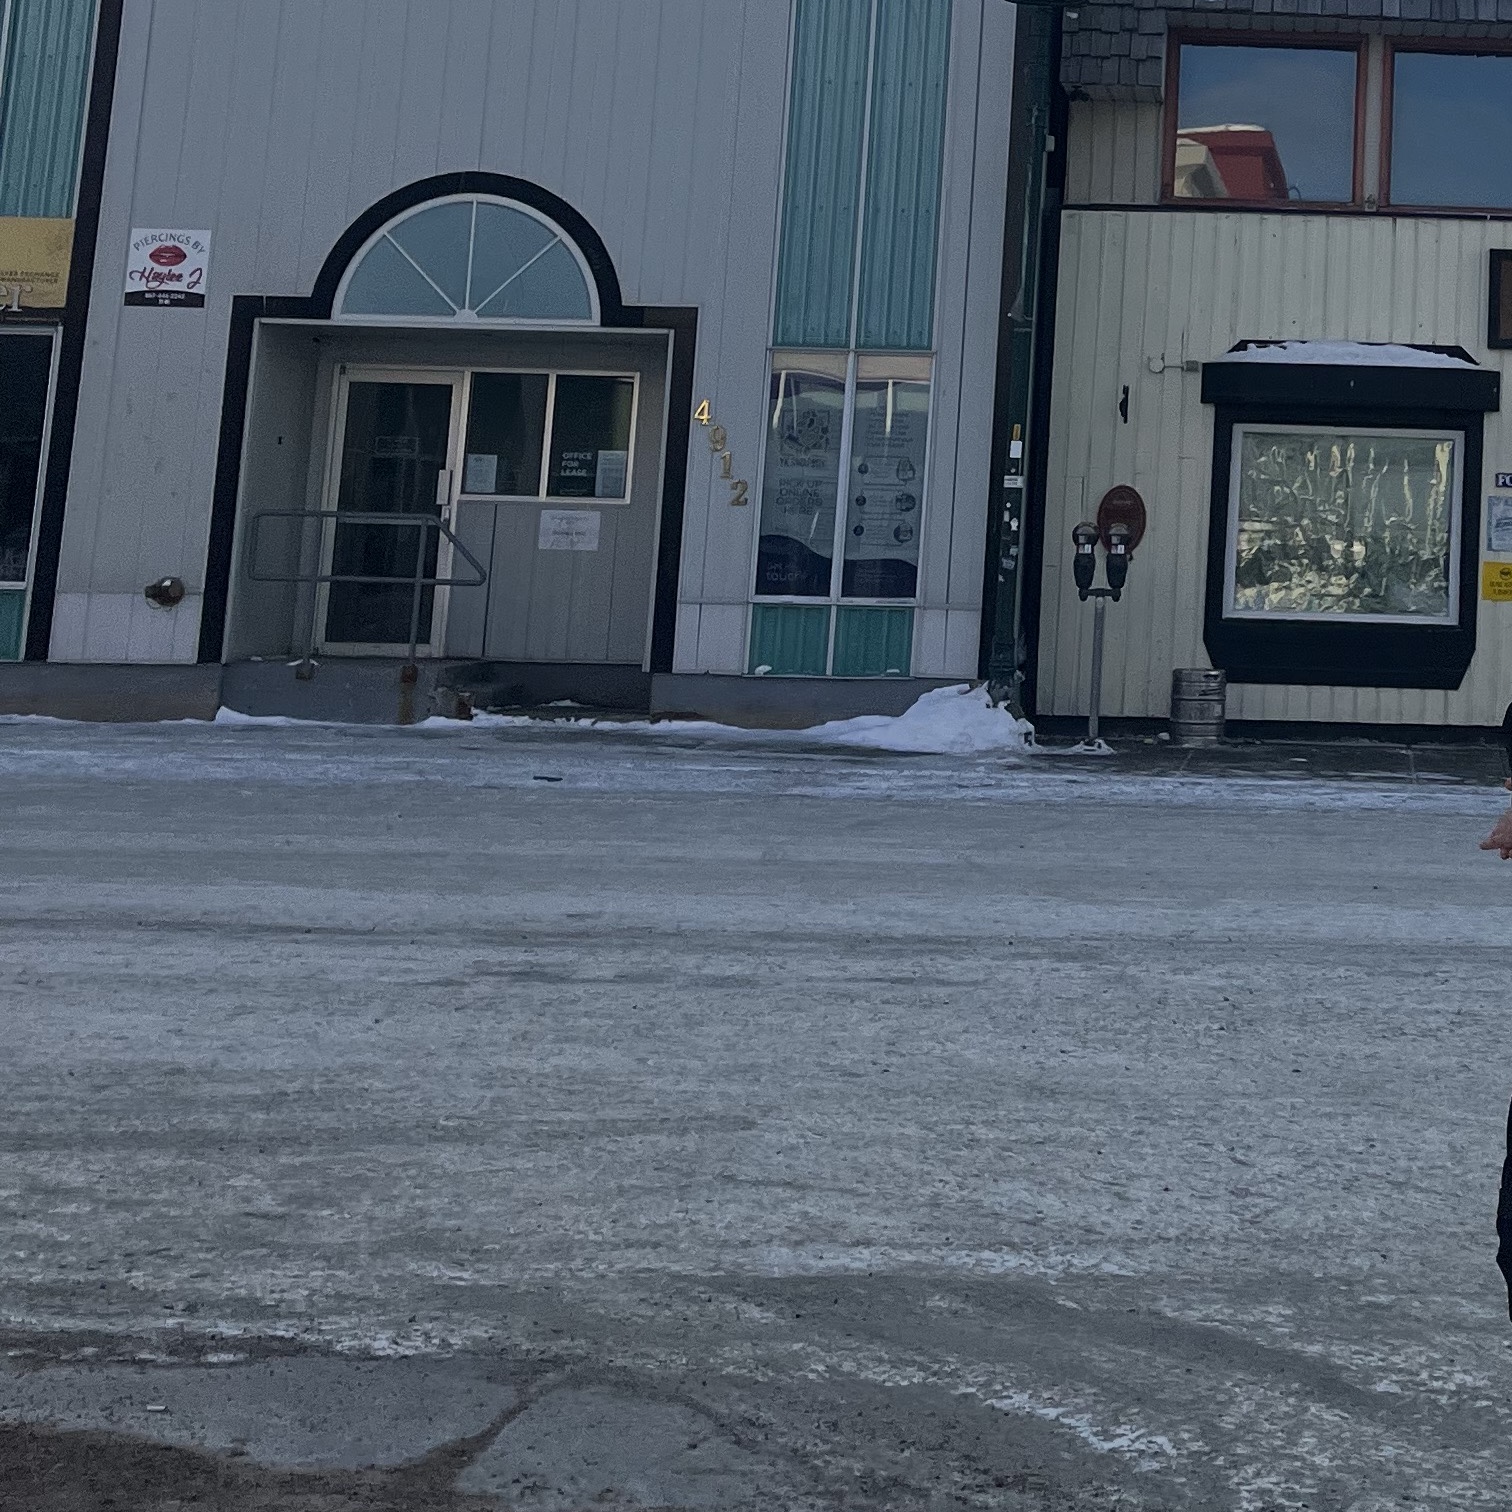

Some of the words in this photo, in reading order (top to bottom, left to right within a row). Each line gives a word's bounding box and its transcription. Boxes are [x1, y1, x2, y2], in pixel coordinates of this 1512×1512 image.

[133, 233, 191, 251] PIERCINGS
[191, 240, 207, 255] BY
[562, 452, 593, 460] OFFICE
[693, 399, 748, 507] 4912
[560, 468, 588, 477] LEASE
